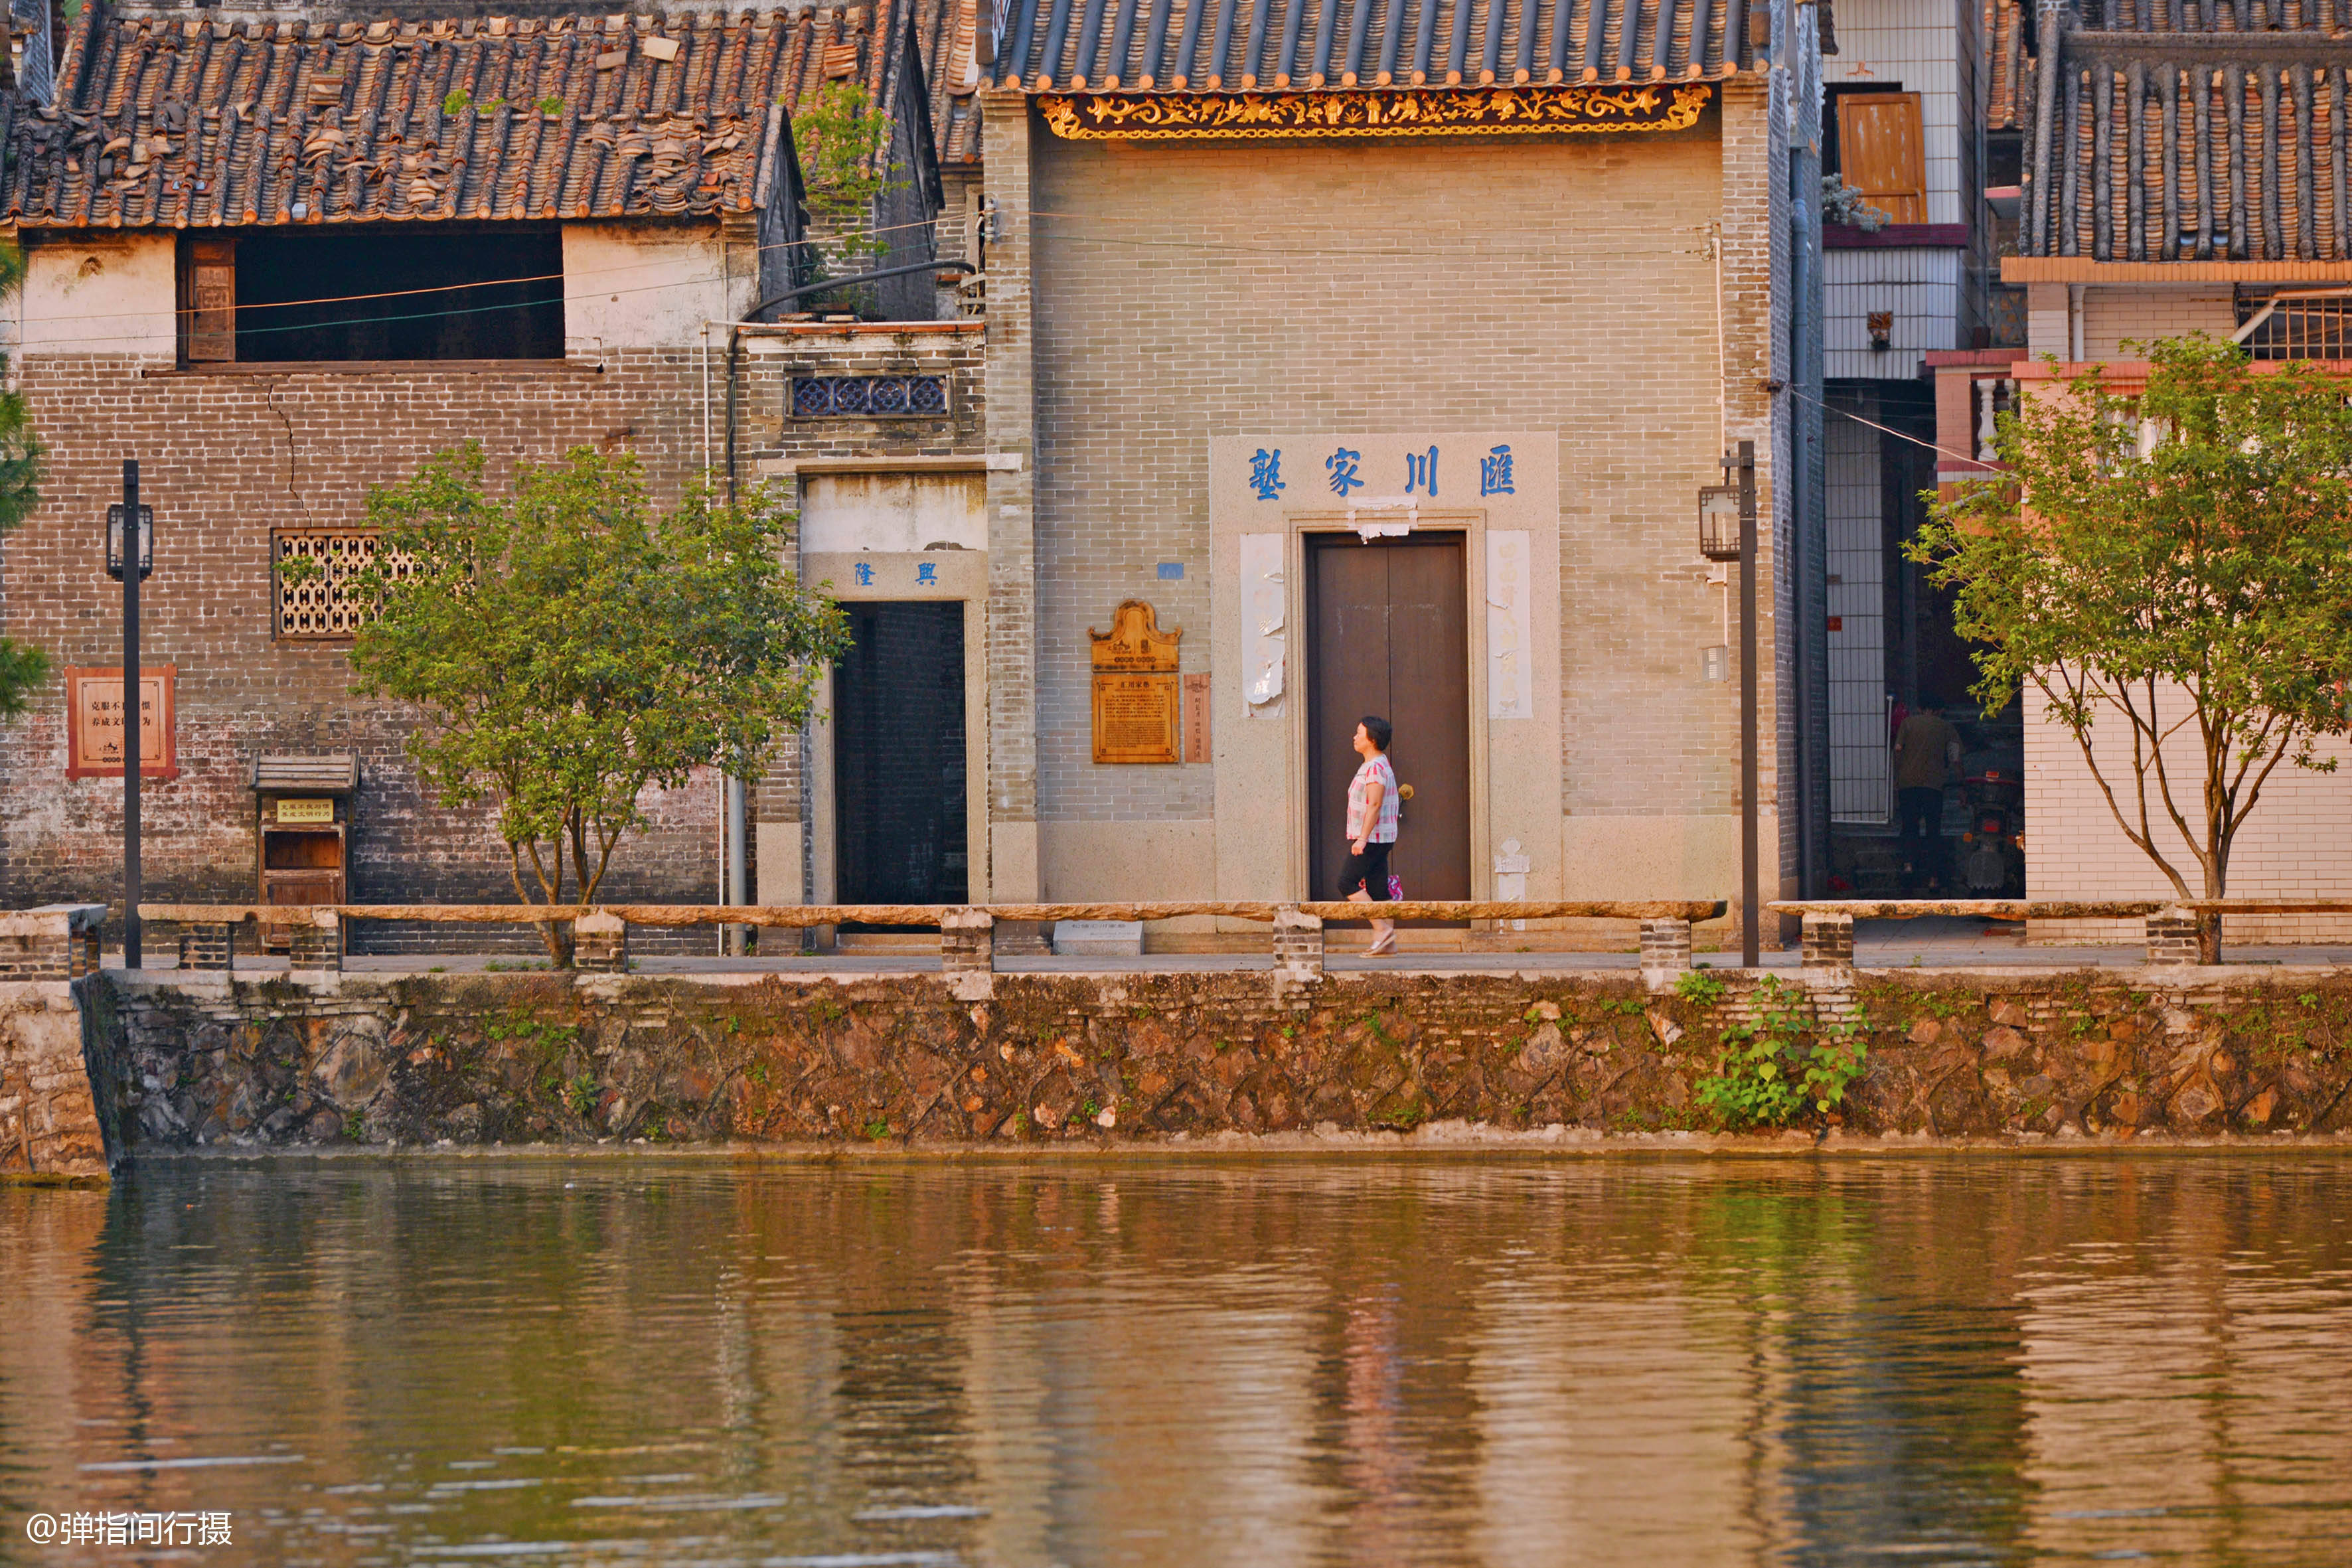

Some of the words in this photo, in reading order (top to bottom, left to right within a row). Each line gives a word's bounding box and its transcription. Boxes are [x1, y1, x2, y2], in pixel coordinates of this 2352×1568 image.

[92, 701, 151, 711] 克服不惯
[92, 717, 151, 727] 养成文为
